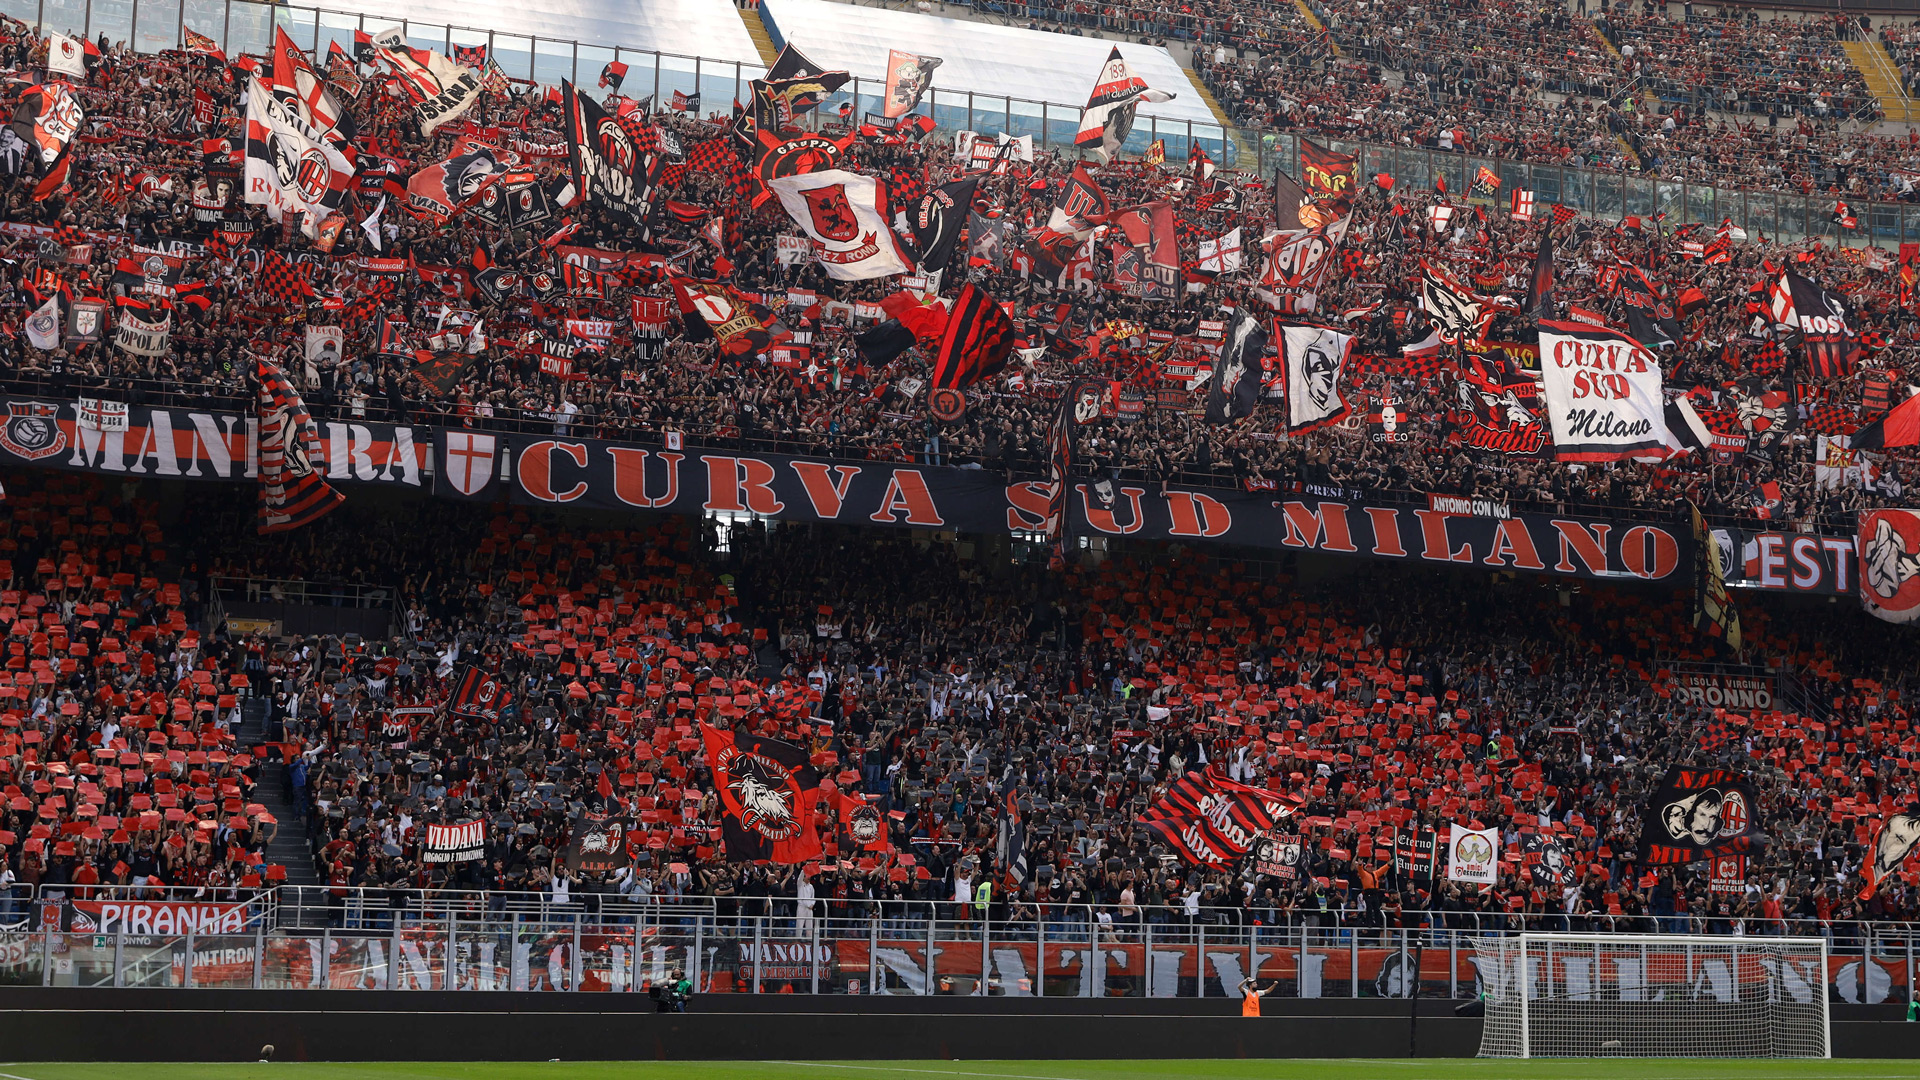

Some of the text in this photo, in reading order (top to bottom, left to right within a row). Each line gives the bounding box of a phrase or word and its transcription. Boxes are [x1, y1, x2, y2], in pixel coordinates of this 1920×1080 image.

[515, 140, 547, 156] NORD
[777, 138, 838, 156] GRUPPO
[224, 221, 254, 233] EMILIA
[790, 251, 808, 264] 78
[845, 242, 879, 262] ROMA
[633, 299, 647, 318] TI
[736, 315, 758, 333] SUD
[1570, 312, 1605, 327] SONDRIO
[540, 356, 563, 373] CON
[1554, 340, 1649, 375] CURVA
[1572, 370, 1631, 400] SUD
[1369, 395, 1405, 406] PIAZZA
[1566, 408, 1653, 438] Milano
[1372, 431, 1409, 443] GRECO
[1460, 410, 1545, 455] Banditi
[516, 440, 1680, 579] CURVA SUD MILANO
[1433, 496, 1511, 519] ANTONIO CON NOI
[1756, 533, 1855, 595] EST
[1688, 676, 1767, 690] ISOLA VIRGINIA
[428, 821, 484, 851] VIADANA
[1397, 833, 1432, 849] Eterno
[423, 850, 451, 863] ORGOGLIO
[1399, 849, 1412, 857] ACM
[1396, 856, 1430, 873] Amore
[1466, 863, 1483, 871] amici
[1710, 884, 1745, 893] BISCEGLIE
[100, 903, 244, 935] PIRANHA
